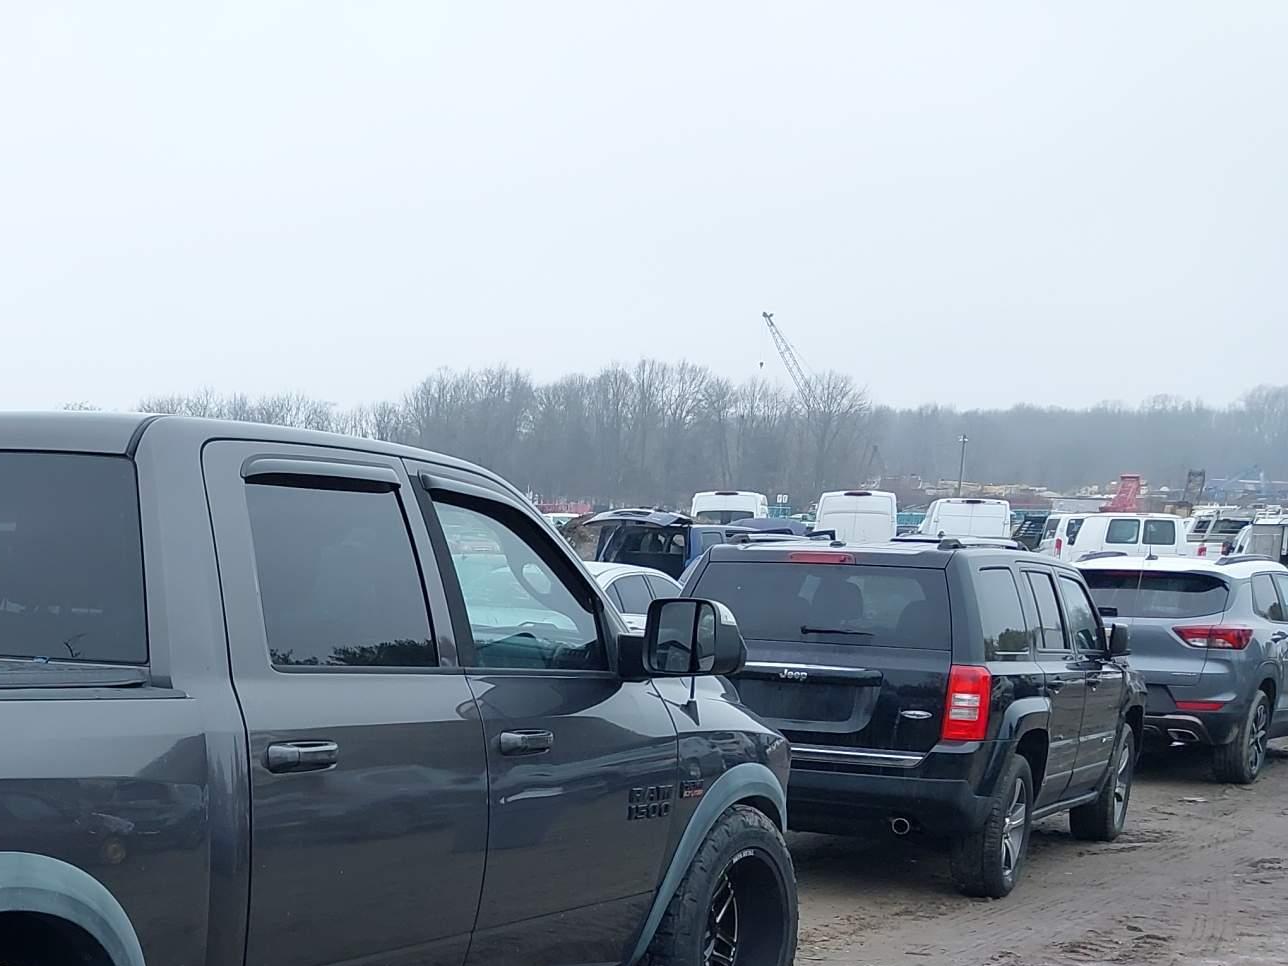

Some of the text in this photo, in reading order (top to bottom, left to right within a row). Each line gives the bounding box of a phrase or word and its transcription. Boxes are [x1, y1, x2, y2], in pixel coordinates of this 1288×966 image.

[778, 668, 808, 682] Jeep
[629, 784, 674, 803] RAM
[627, 801, 673, 820] 1500
